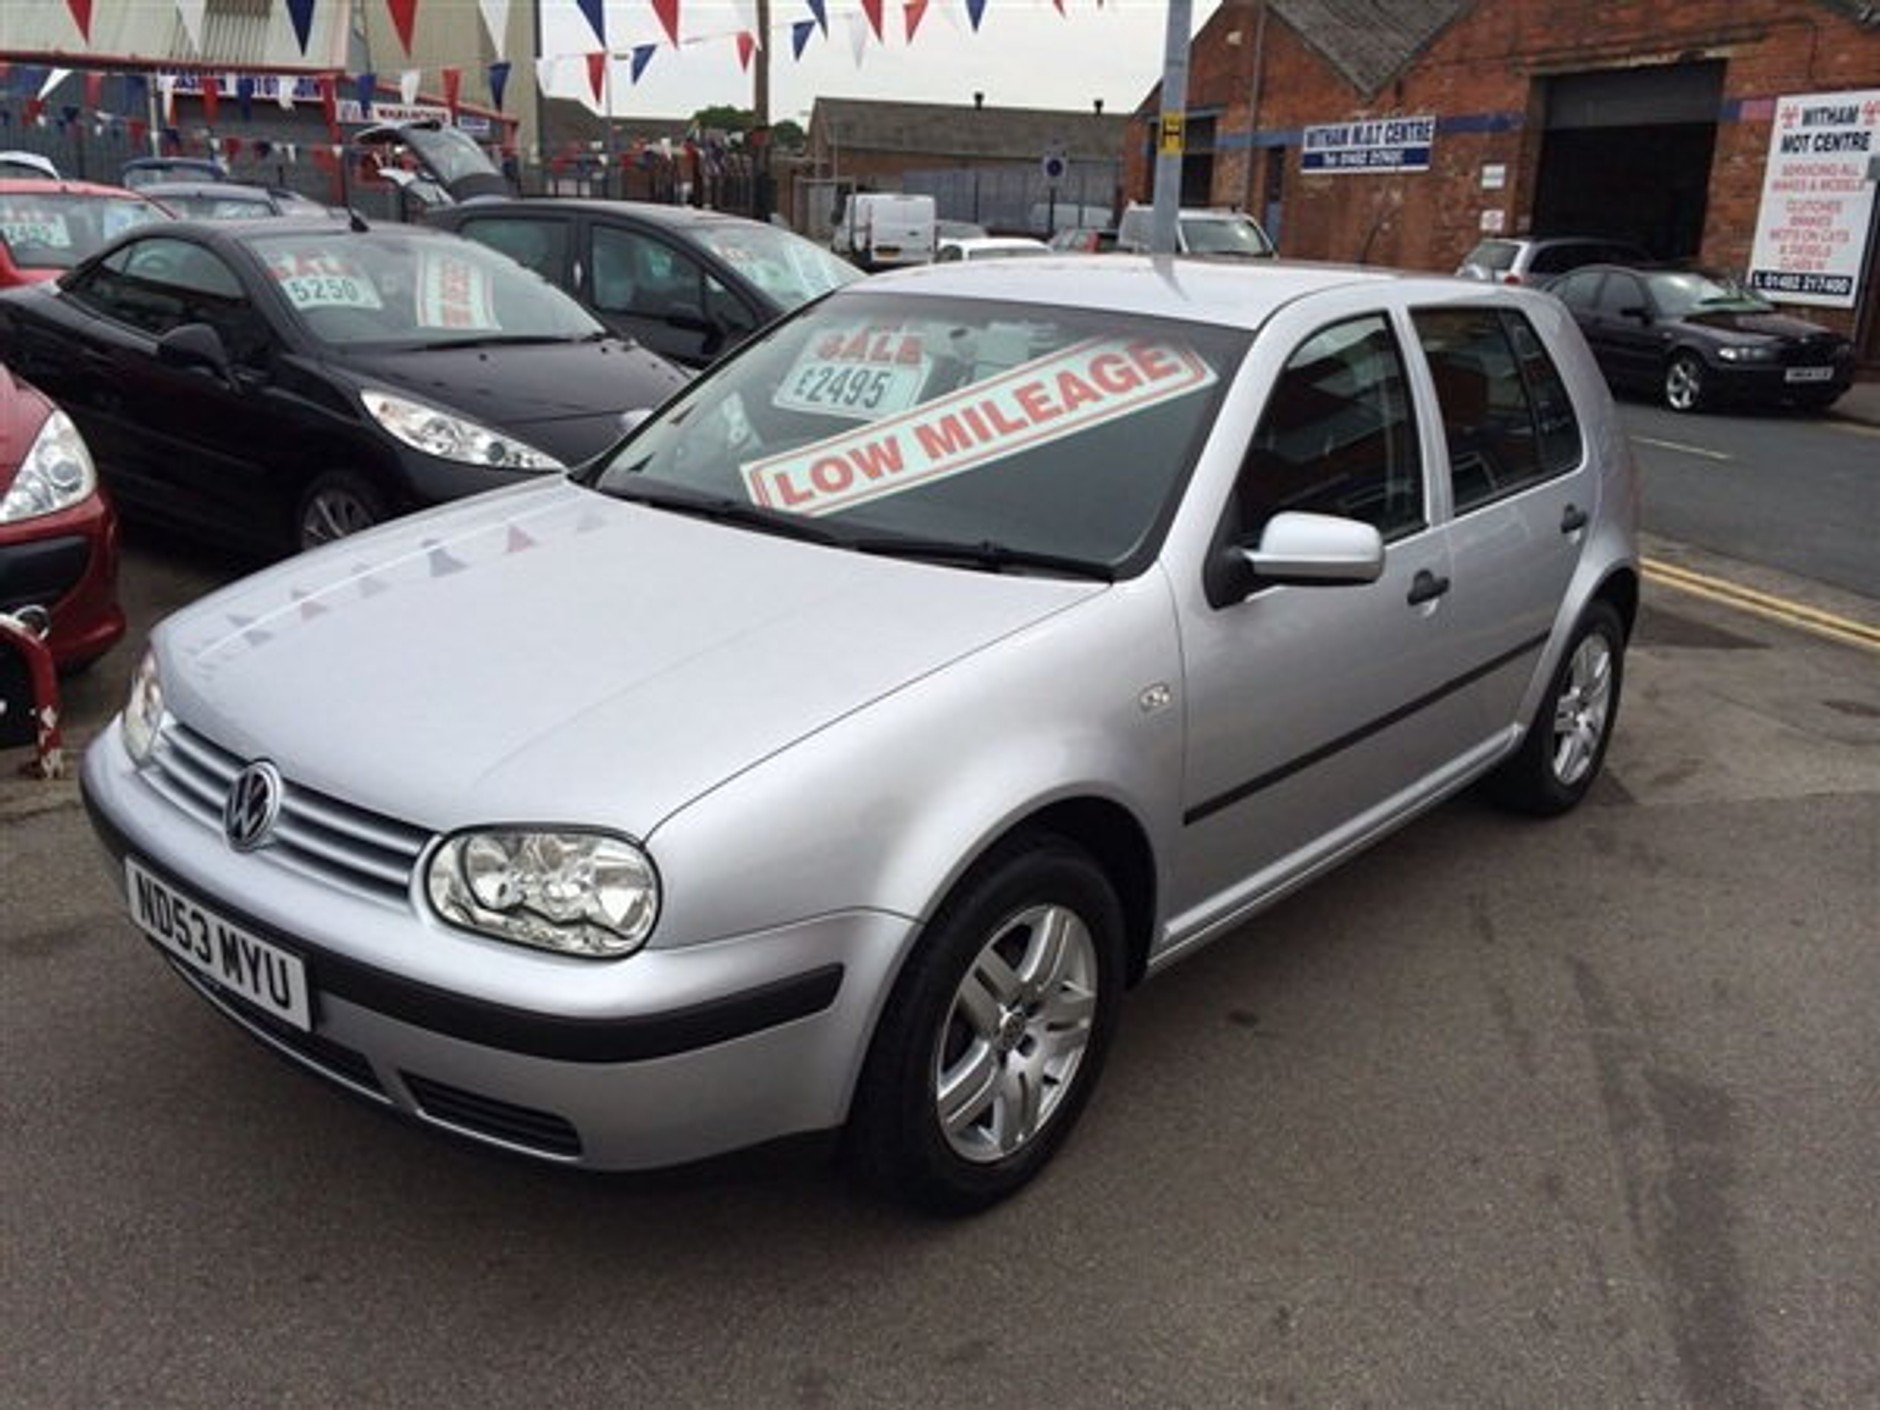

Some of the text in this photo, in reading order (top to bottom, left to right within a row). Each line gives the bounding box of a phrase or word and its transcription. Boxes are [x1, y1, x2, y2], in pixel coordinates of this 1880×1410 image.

[1802, 104, 1859, 127] WITHAM
[1306, 127, 1348, 148] WITHAM
[1384, 120, 1432, 144] CENTRE
[1780, 130, 1871, 154] MOT CENTRE
[1840, 163, 1860, 176] ALL
[817, 328, 922, 364] SALE
[794, 365, 891, 409] £2495
[774, 337, 1181, 506] LOW MILEAGE
[136, 871, 291, 1010] ND53 MYU
